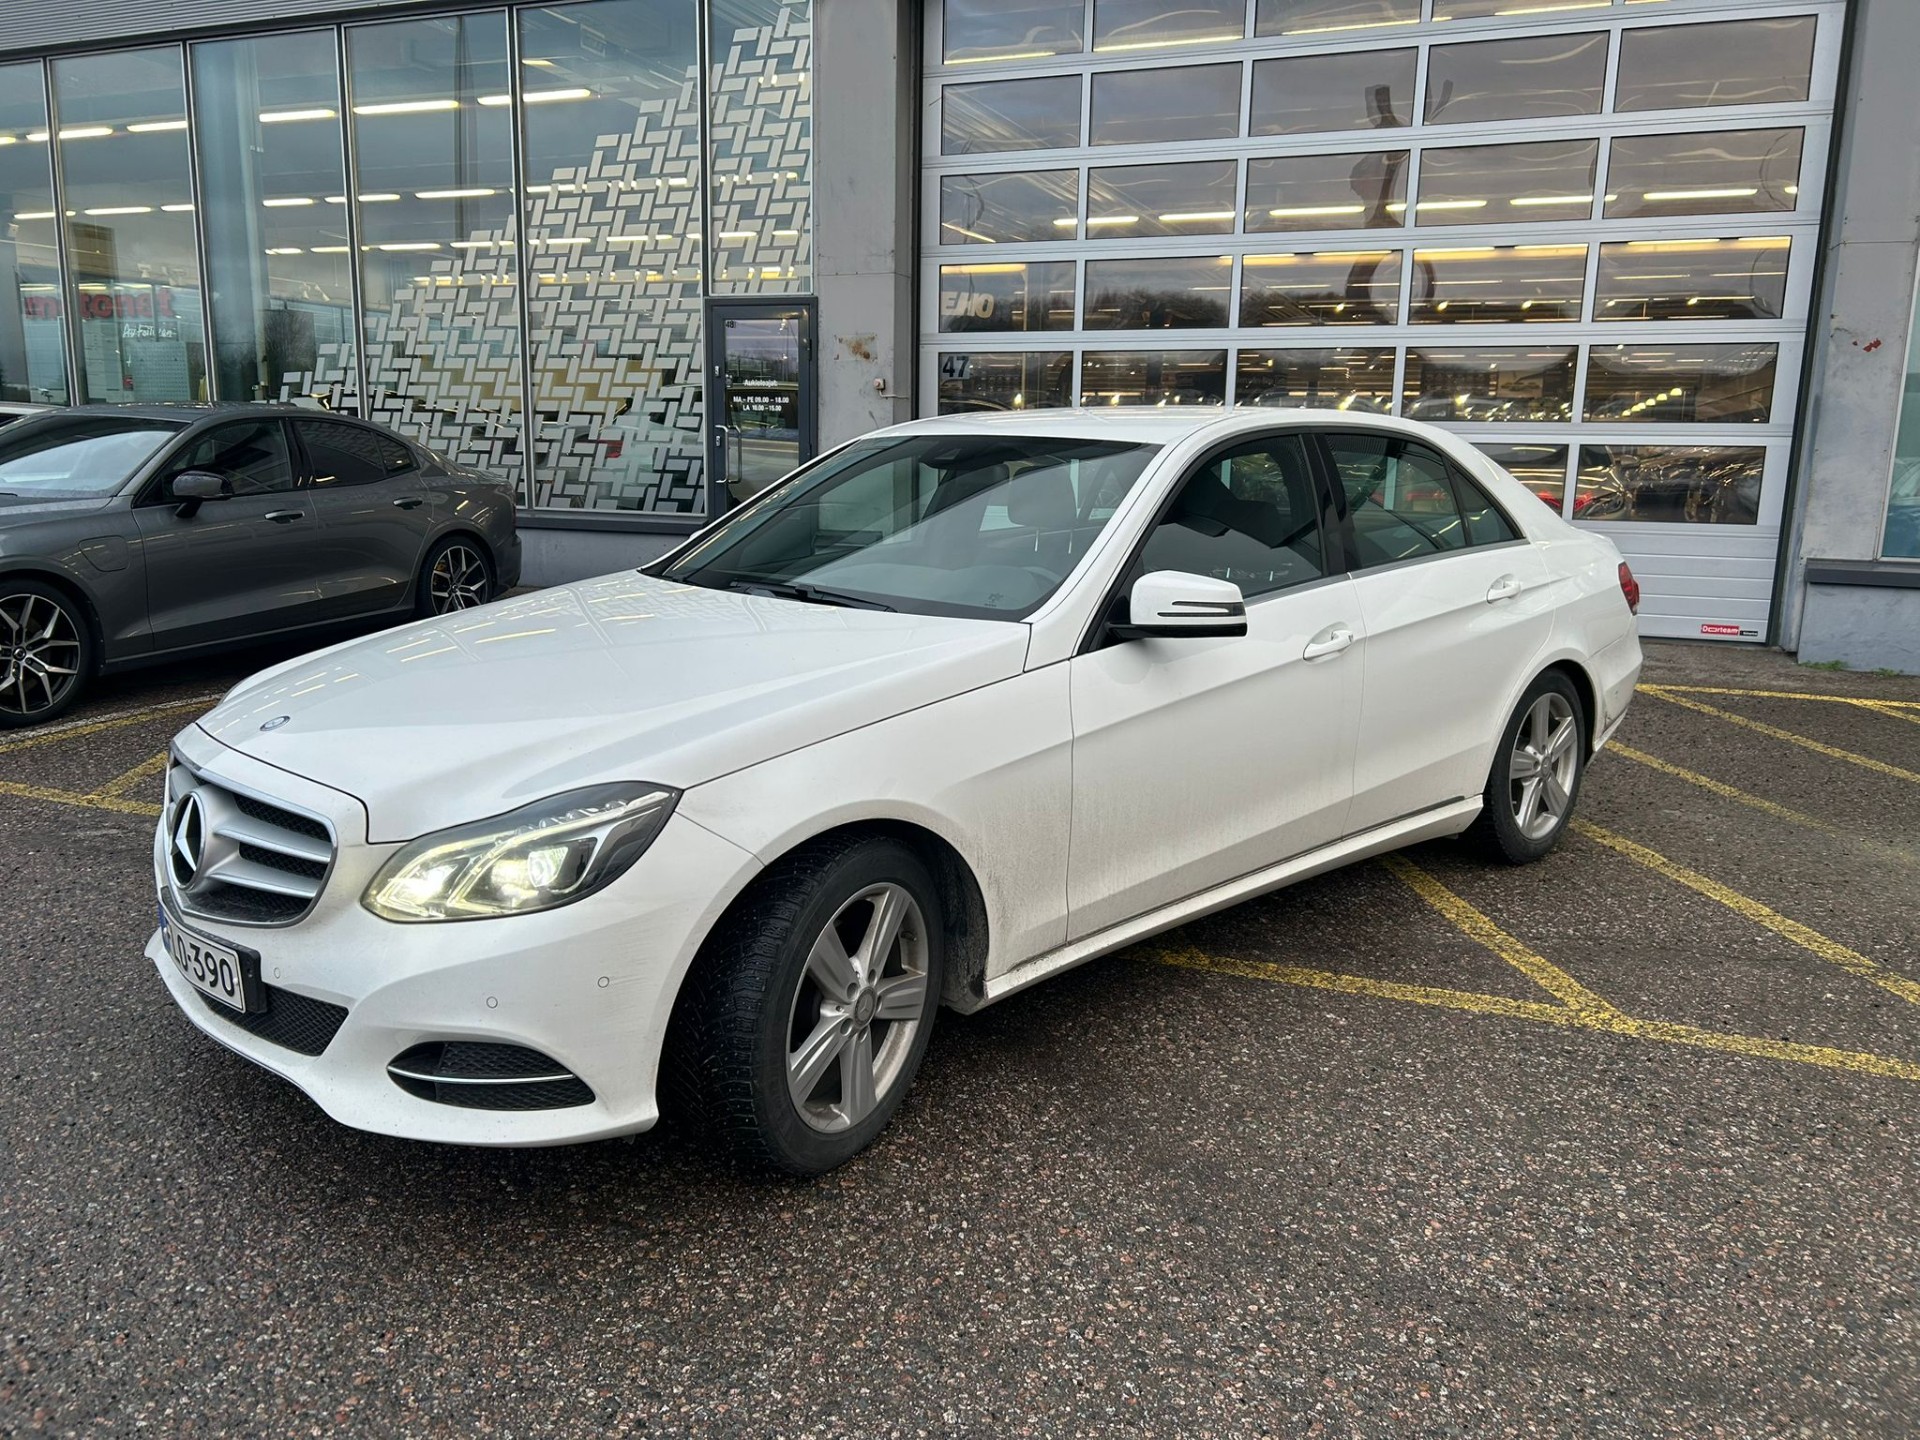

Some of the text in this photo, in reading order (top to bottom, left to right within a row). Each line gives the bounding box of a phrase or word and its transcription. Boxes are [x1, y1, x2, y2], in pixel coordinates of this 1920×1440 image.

[24, 288, 175, 319] mtonet
[941, 291, 994, 319] EHO
[942, 355, 969, 378] 47
[1702, 625, 1738, 634] Doorteam
[168, 920, 235, 997] LO-390
